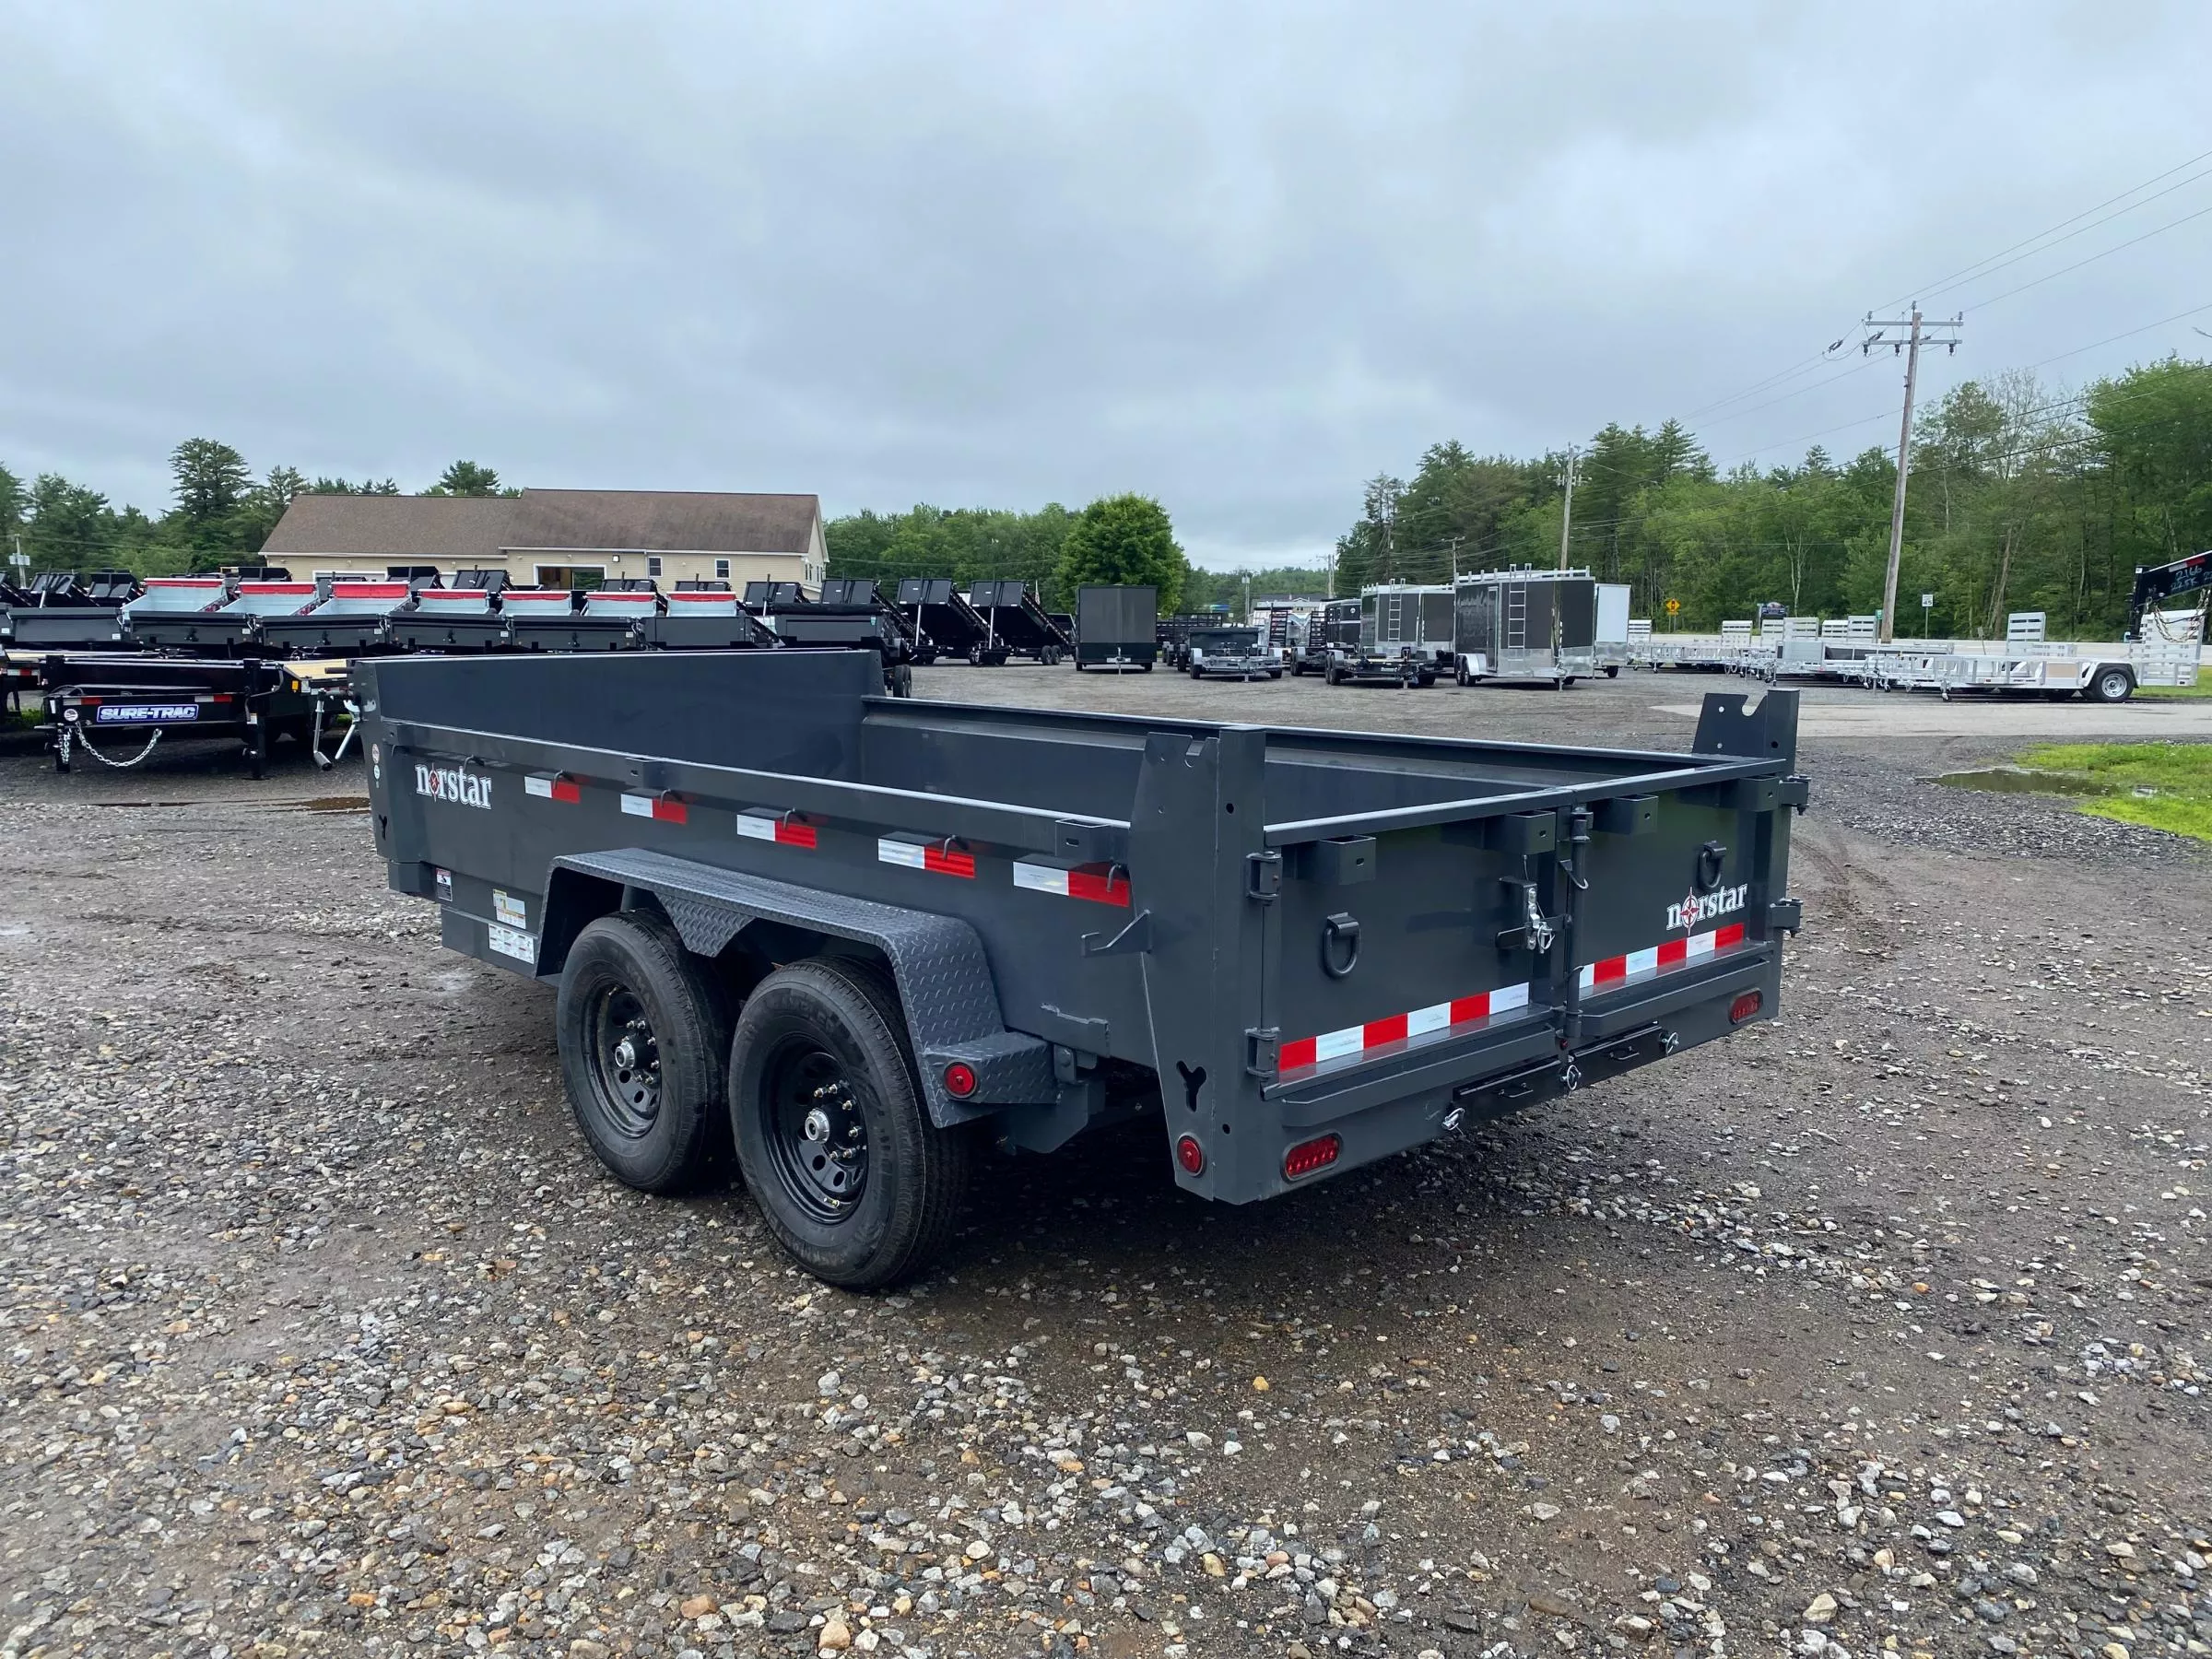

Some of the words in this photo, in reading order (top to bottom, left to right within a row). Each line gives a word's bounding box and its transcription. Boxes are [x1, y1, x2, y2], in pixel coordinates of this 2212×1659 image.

[100, 706, 196, 720] SURE-TRAC
[415, 763, 492, 810] norstar
[1665, 883, 1748, 933] norstar
